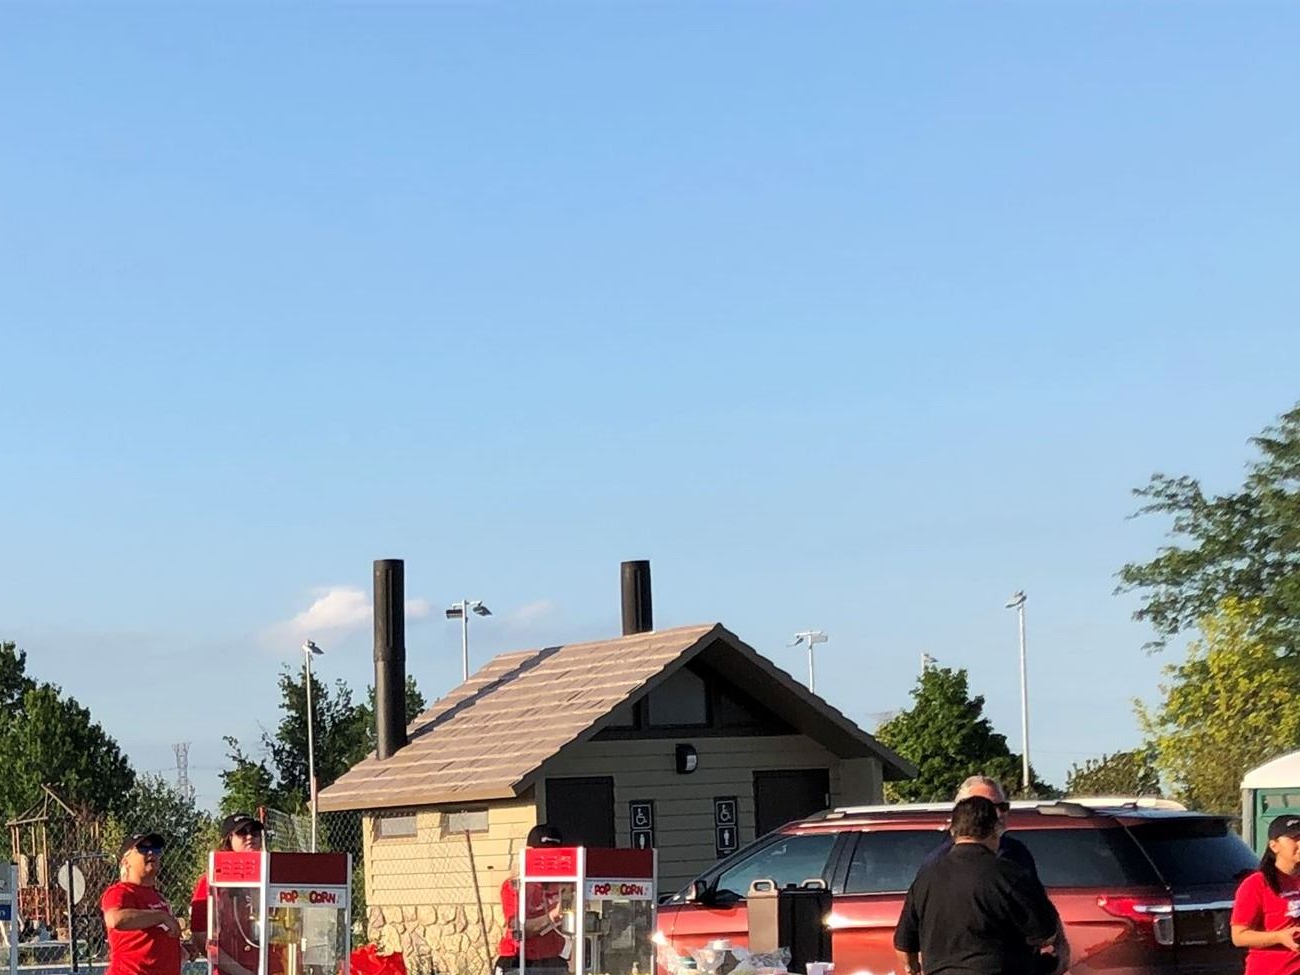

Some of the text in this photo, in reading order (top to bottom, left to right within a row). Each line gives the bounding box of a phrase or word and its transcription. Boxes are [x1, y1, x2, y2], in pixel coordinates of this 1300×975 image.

[594, 882, 644, 897] POP CORN
[279, 890, 337, 905] POP CORN
